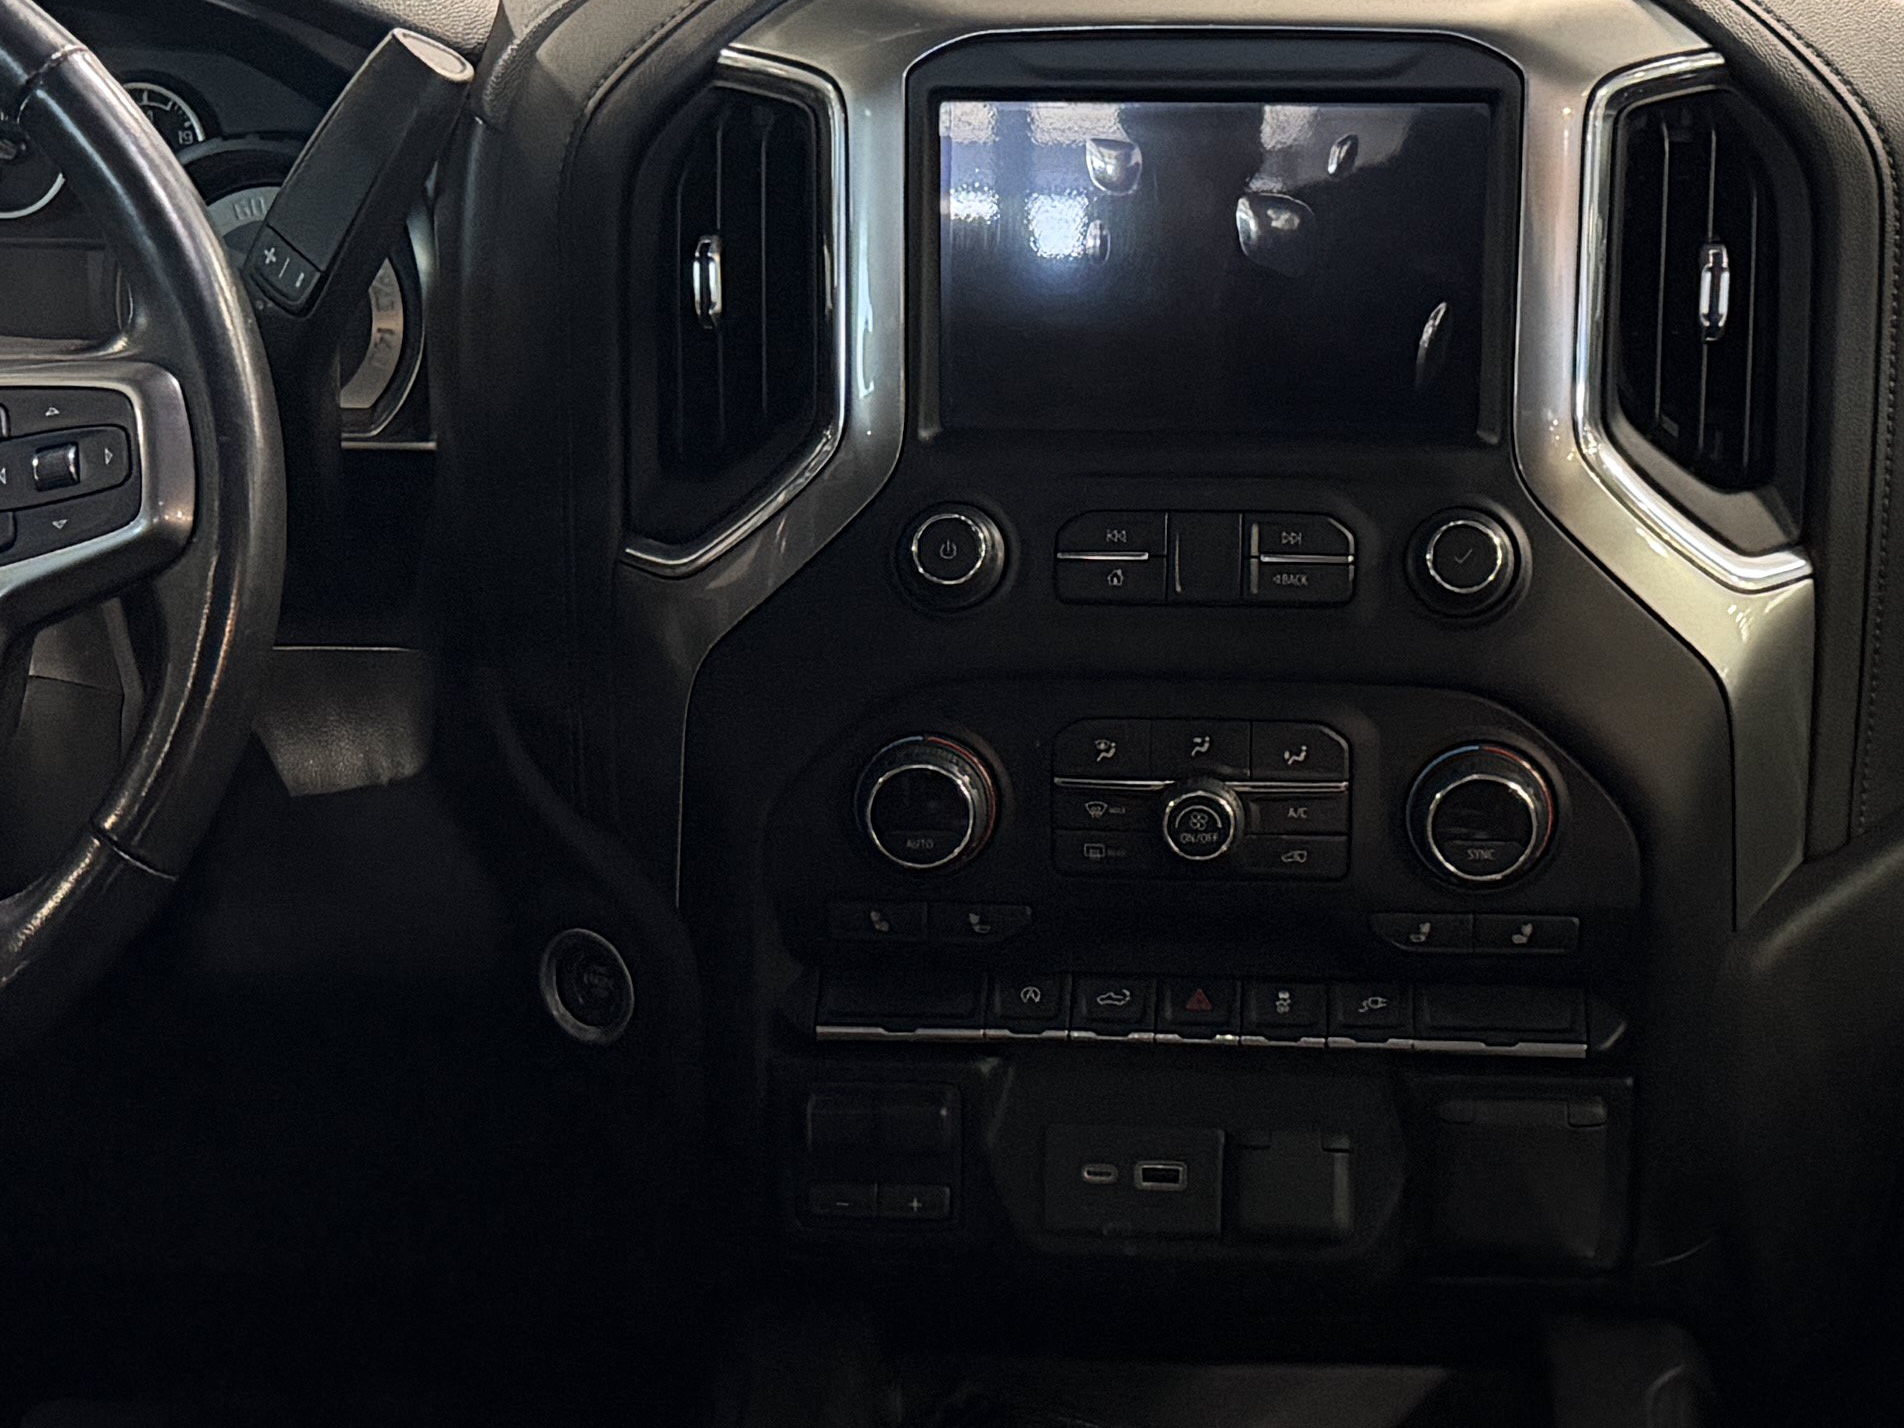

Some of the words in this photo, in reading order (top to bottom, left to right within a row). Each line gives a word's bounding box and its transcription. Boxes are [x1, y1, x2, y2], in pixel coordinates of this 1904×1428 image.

[1281, 573, 1310, 586] BACK
[1286, 807, 1309, 819] A/C
[905, 837, 935, 850] AUTO
[1179, 831, 1219, 845] ON/OFF
[1466, 847, 1498, 861] SYNC
